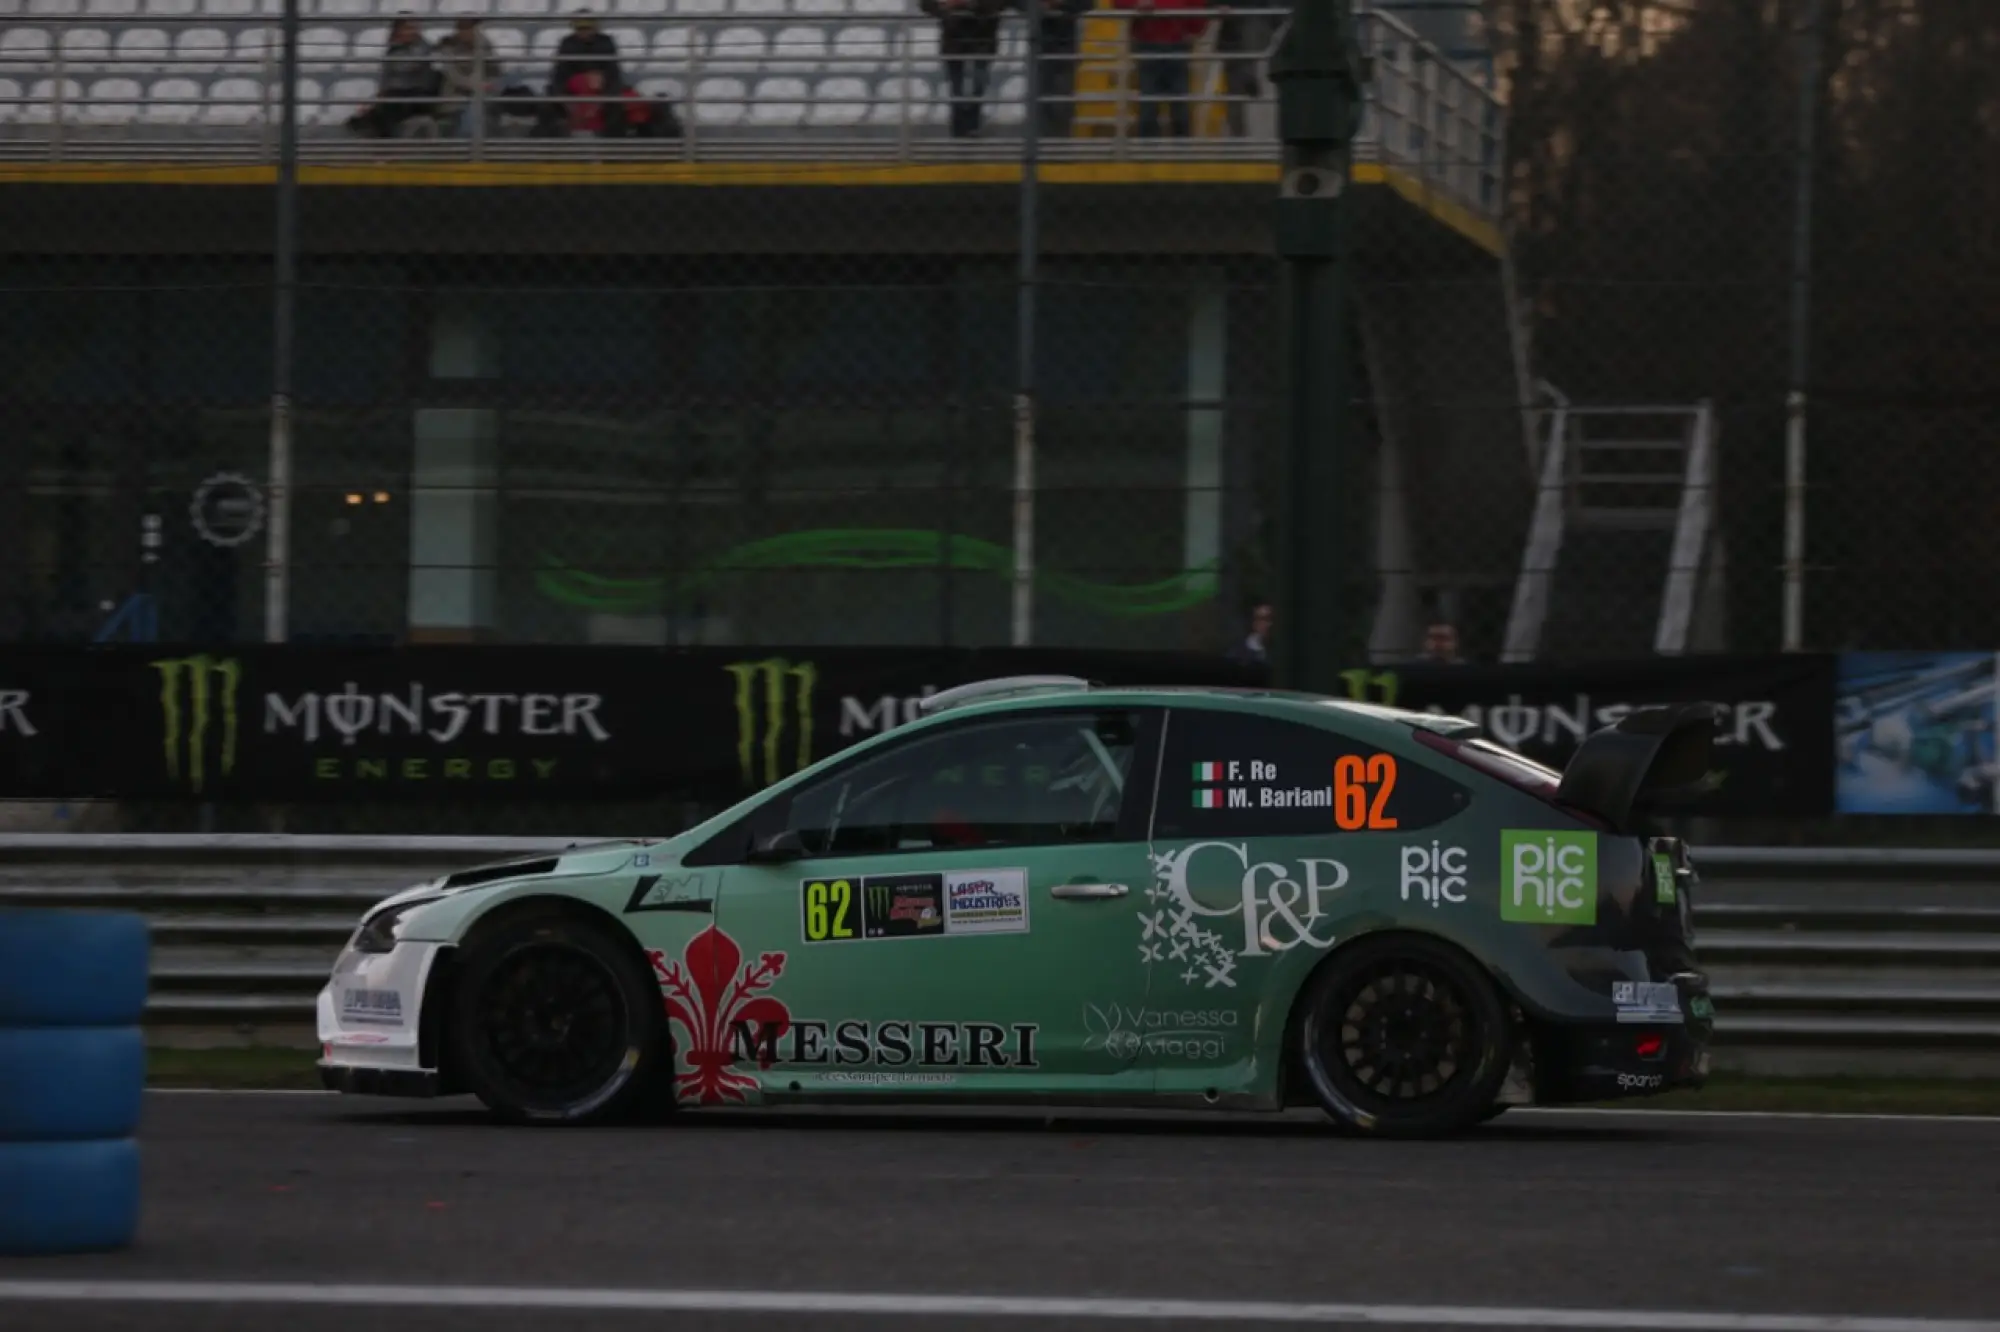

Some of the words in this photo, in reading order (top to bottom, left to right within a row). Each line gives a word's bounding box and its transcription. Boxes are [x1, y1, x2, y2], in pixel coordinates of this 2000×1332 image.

[263, 681, 611, 744] MONSTER
[316, 757, 558, 780] ENERGY
[1227, 760, 1244, 782] F.
[1250, 759, 1278, 781] Re
[1227, 787, 1253, 808] M.
[1260, 785, 1333, 808] Bariani
[1333, 752, 1399, 831] 62
[1400, 839, 1468, 876] pic
[1513, 836, 1585, 876] pic
[805, 880, 854, 940] 62
[1125, 1006, 1238, 1028] Vanessa
[732, 1019, 1038, 1066] MESSERI
